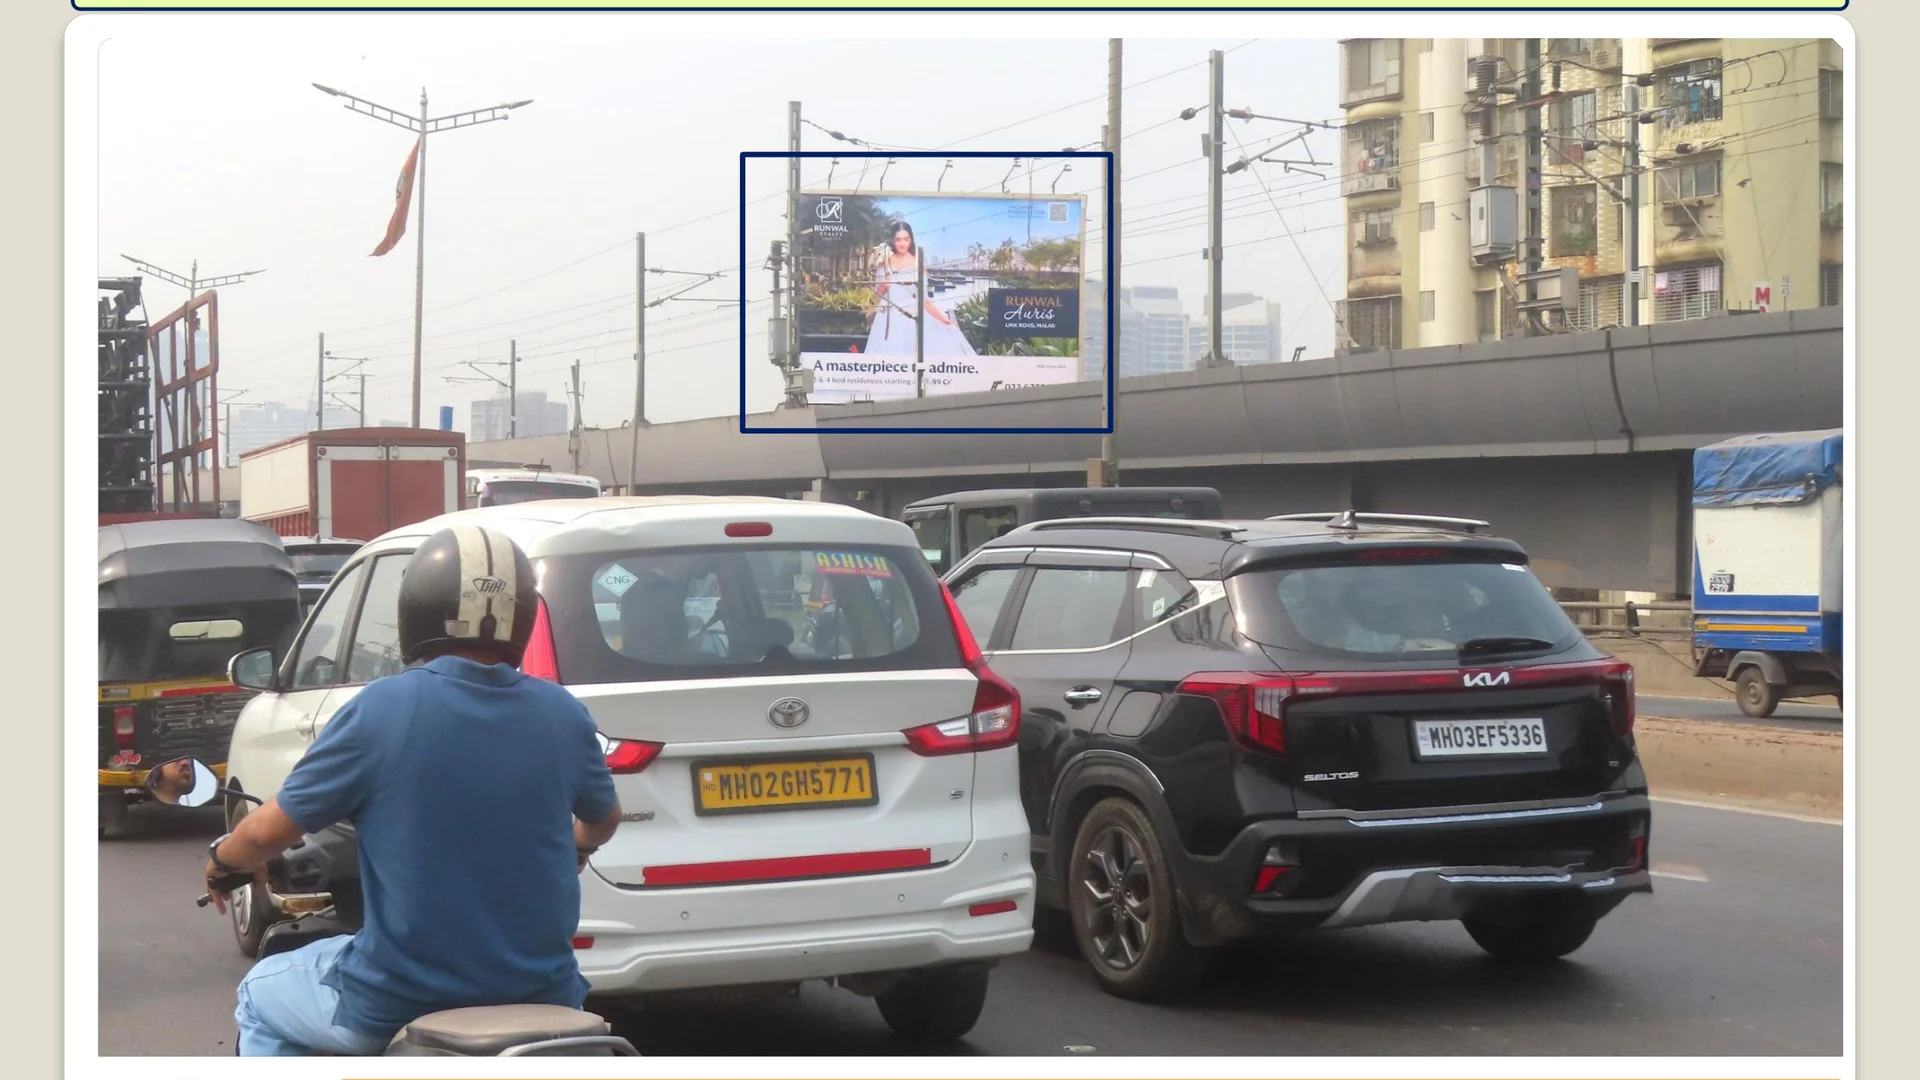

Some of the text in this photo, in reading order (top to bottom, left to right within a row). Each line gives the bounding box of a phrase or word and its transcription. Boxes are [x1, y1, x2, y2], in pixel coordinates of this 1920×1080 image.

[1006, 296, 1063, 307] RUNWAL
[1004, 303, 1055, 320] Auris
[813, 359, 824, 371] A
[826, 360, 908, 374] masterpiece
[929, 362, 979, 374] admire.
[832, 376, 846, 384] bed
[847, 377, 883, 385] residences
[884, 378, 911, 386] starting
[605, 575, 630, 585] CNG
[1463, 671, 1510, 687] KIA
[1429, 724, 1543, 749] MH03EF5336
[1304, 771, 1359, 782] SELTOS
[702, 783, 717, 792] IND
[719, 766, 866, 801] MH02GH5771
